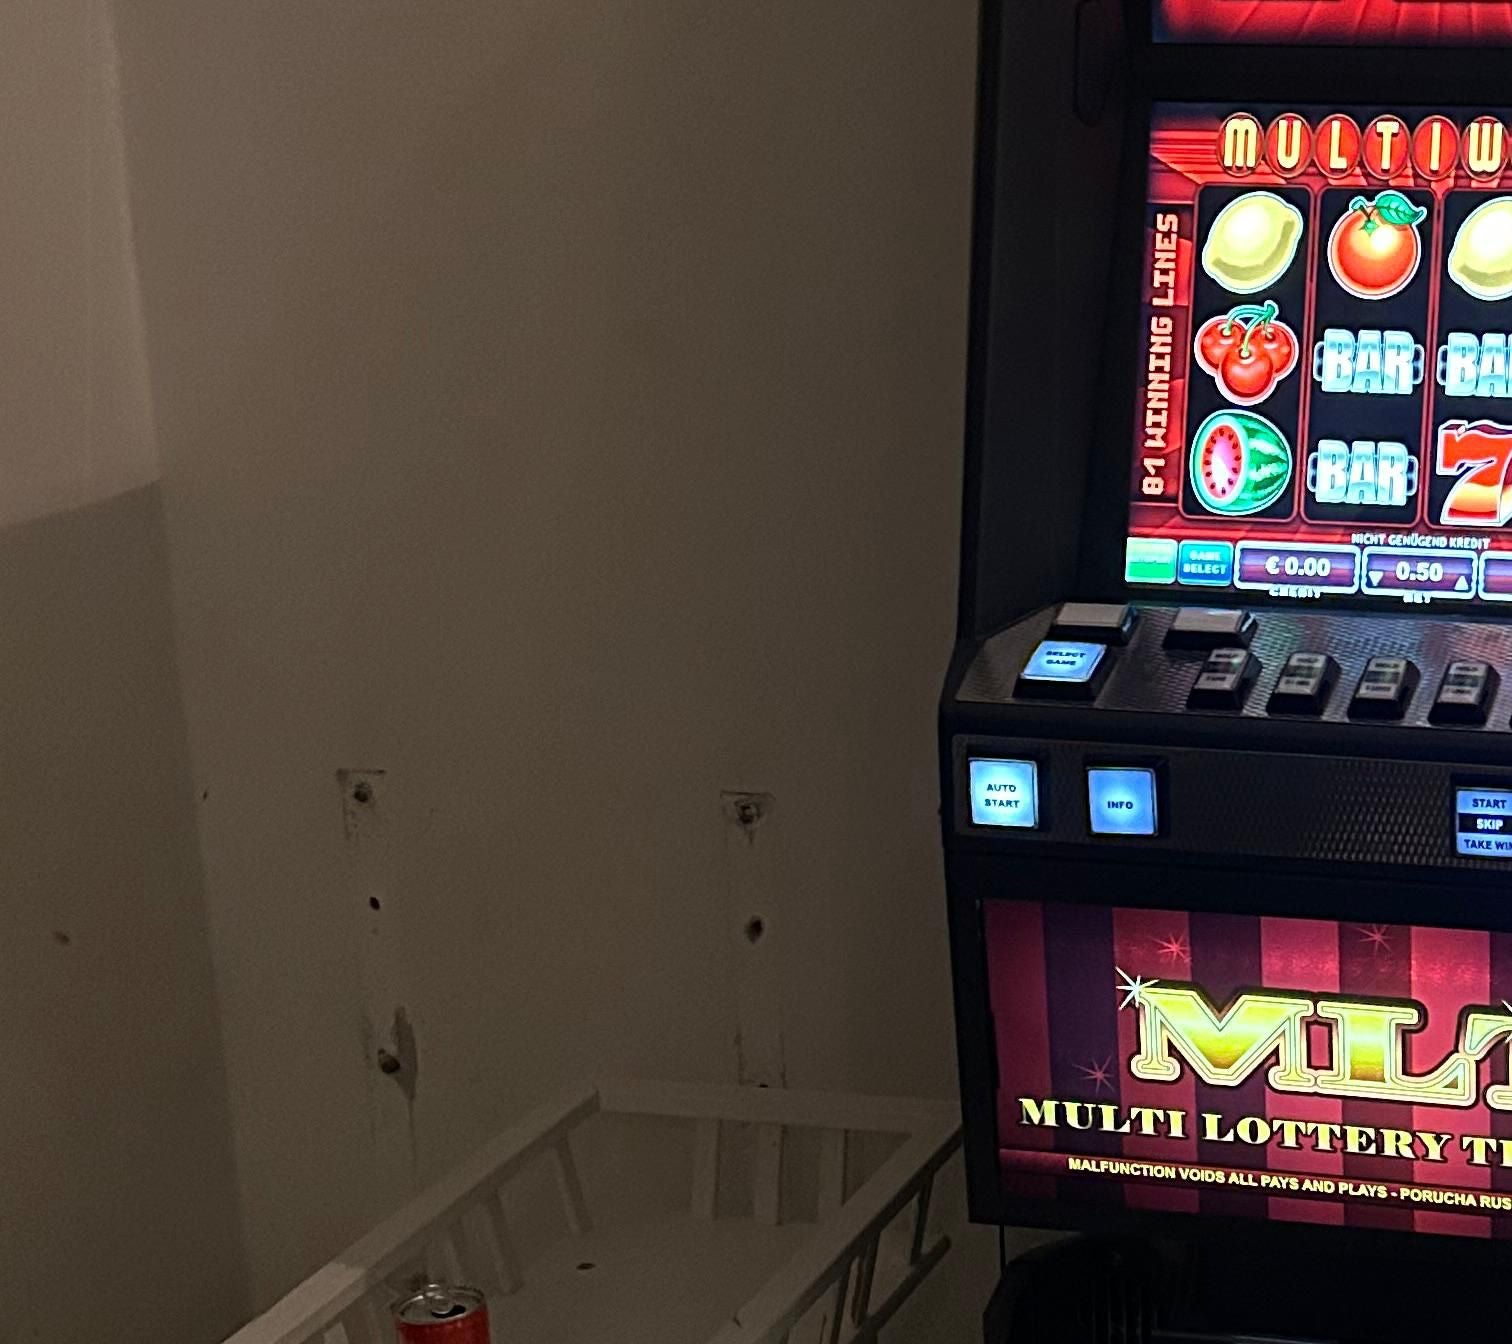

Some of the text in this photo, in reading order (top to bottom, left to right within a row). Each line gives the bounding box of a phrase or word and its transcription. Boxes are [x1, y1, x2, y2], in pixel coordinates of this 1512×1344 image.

[1142, 213, 1178, 495] 81 WINNING LINES
[1321, 329, 1415, 395] BAR
[1316, 440, 1408, 506] BAR
[1351, 531, 1491, 550] NICHT GENÜGEND KREDIT
[1183, 563, 1227, 575] SELECT
[1265, 556, 1331, 577] € 0.00
[1395, 561, 1443, 582] 0.50
[986, 784, 1017, 793] AUTO
[984, 798, 1020, 808] START
[1107, 801, 1133, 809] INFO
[1472, 798, 1507, 809] START
[1476, 818, 1504, 830] SKIP
[1464, 839, 1492, 850] TAKE
[1018, 1098, 1187, 1139] MULTI
[1202, 1113, 1452, 1161] LOTTERY
[1068, 1157, 1176, 1179] MALFUNCTION
[1178, 1168, 1225, 1183] VOIDS
[1229, 1172, 1258, 1187] ALL
[1261, 1175, 1299, 1190] PAYS
[1302, 1179, 1336, 1194] AND
[1339, 1183, 1387, 1198] PLAYS
[1400, 1187, 1476, 1207] PORUCHA
